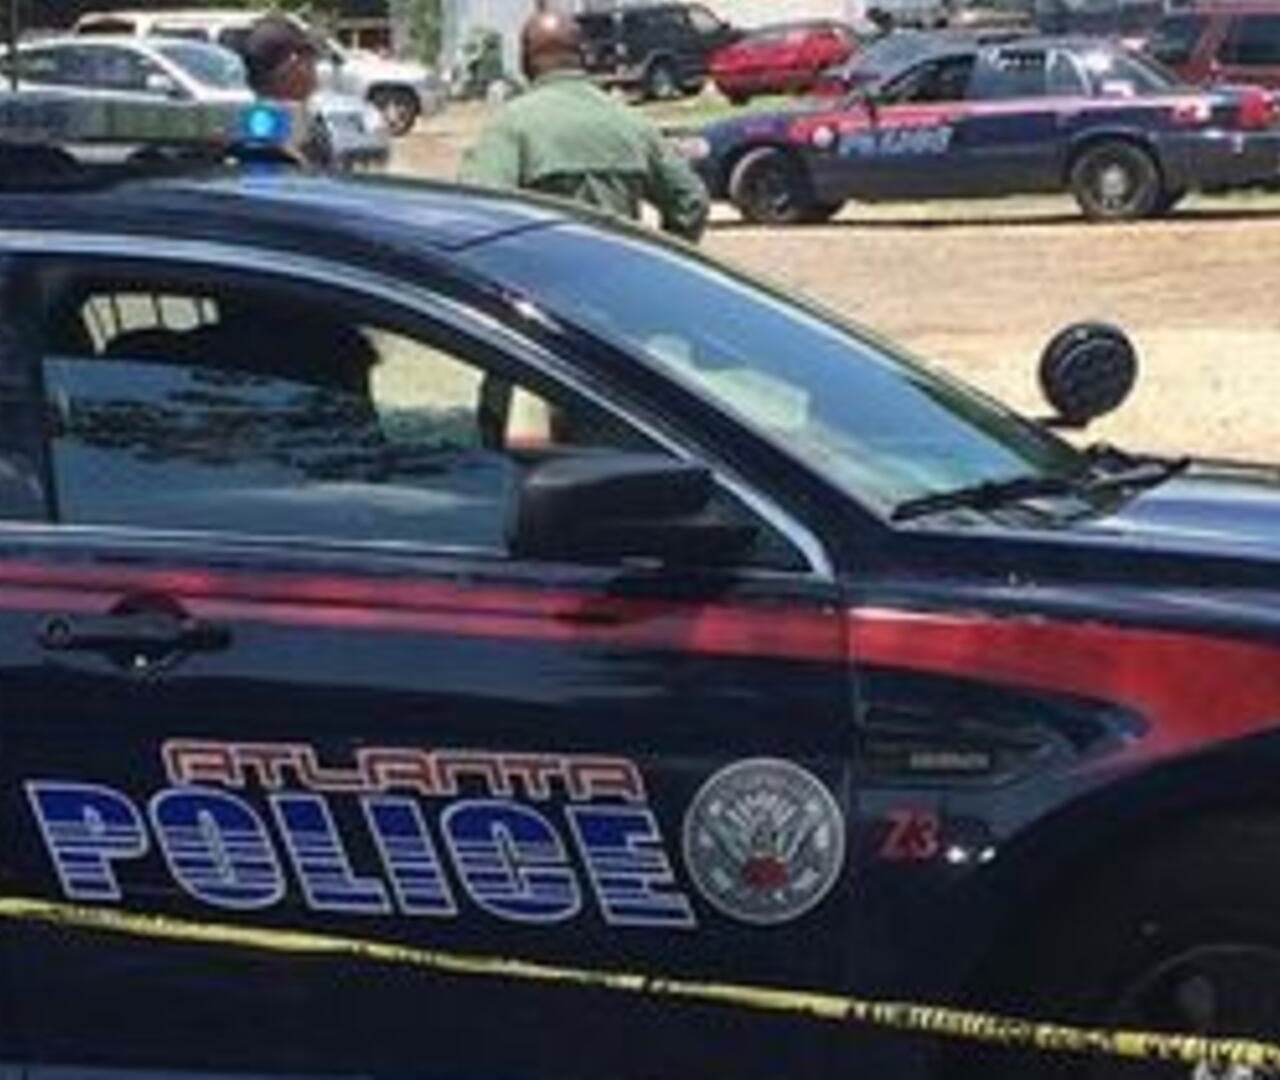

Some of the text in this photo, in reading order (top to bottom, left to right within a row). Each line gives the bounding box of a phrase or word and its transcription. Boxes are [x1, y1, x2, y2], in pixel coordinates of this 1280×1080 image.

[161, 739, 647, 801] ATLANTA
[26, 779, 696, 926] POLICE
[880, 805, 941, 859] Z3
